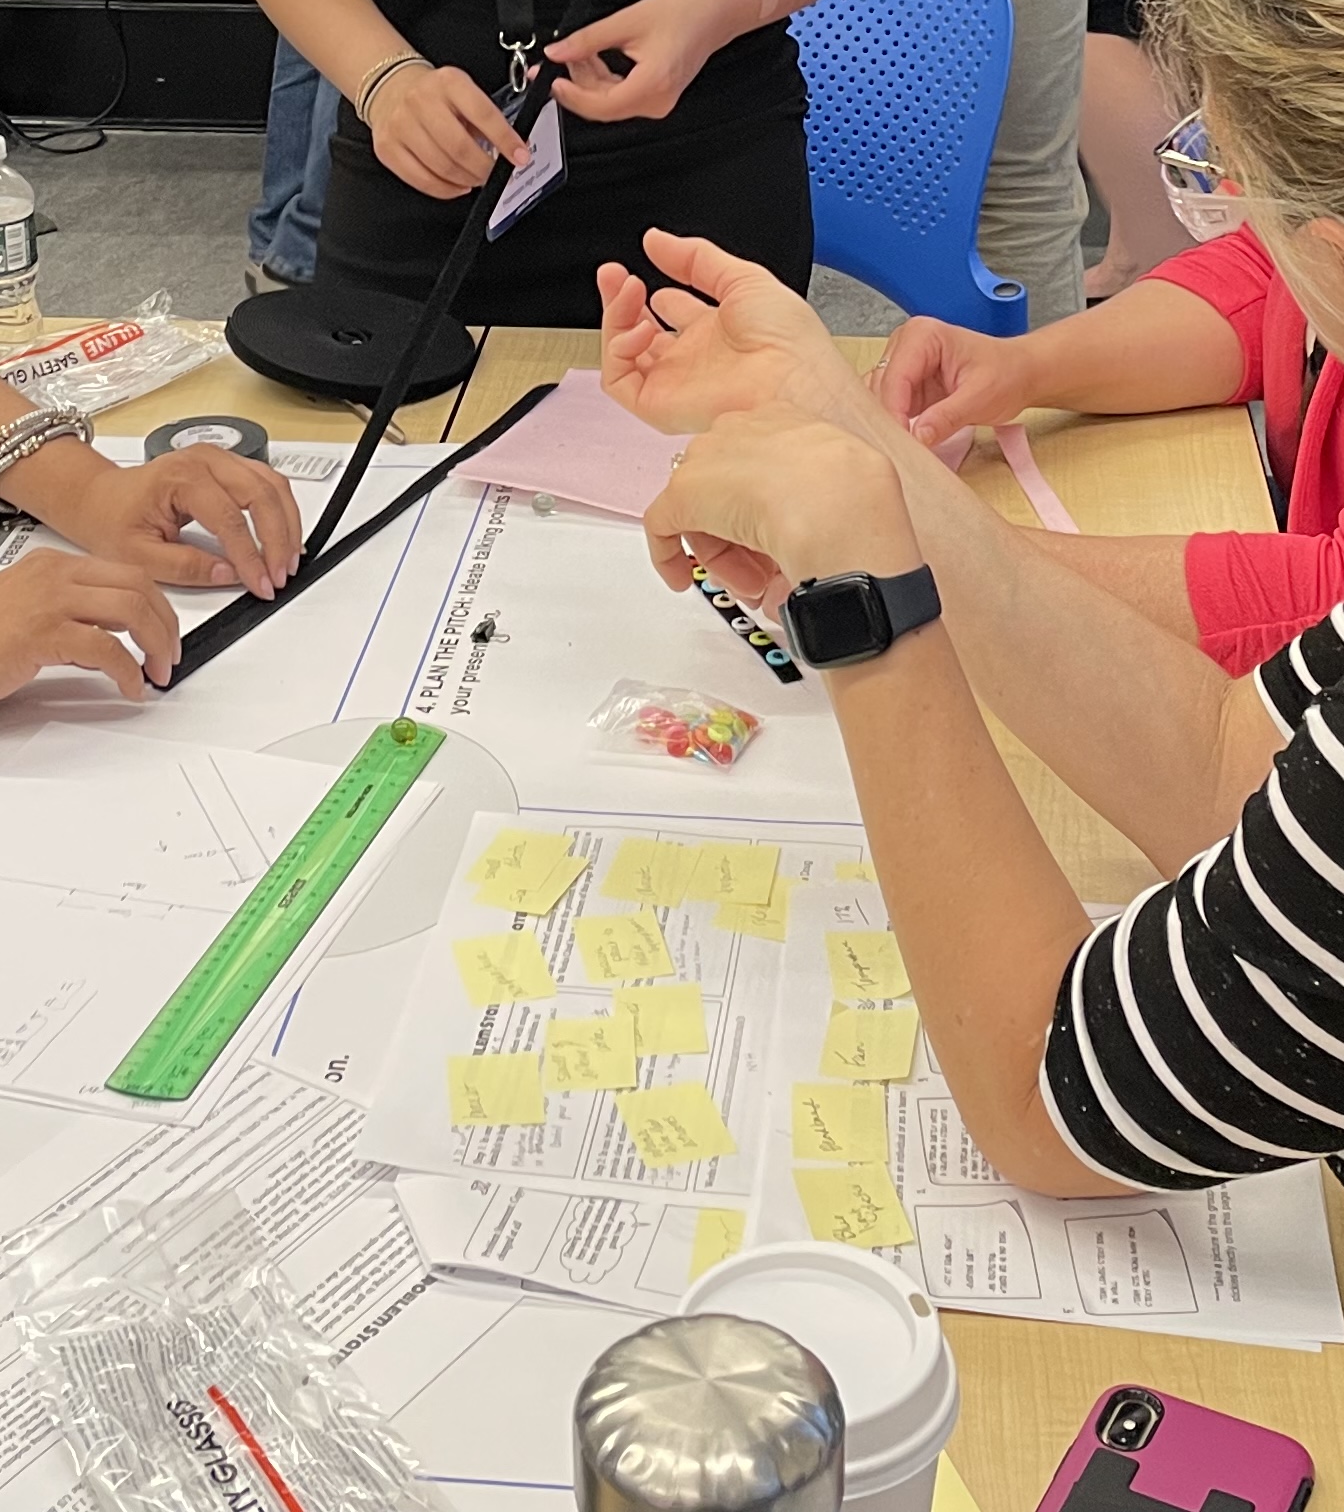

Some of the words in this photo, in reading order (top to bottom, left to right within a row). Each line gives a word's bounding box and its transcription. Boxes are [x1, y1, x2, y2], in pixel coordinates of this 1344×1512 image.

[83, 323, 142, 358] ULINE
[31, 351, 80, 381] SAFETY
[487, 494, 512, 535] points
[472, 527, 504, 562] talking
[458, 561, 486, 596] Ideate
[443, 595, 475, 639] PITCH:
[432, 637, 460, 667] THE
[419, 664, 450, 703] PLAN
[415, 702, 438, 715] 4.
[449, 685, 472, 716] your
[1208, 1213, 1218, 1226] the
[1211, 1237, 1224, 1262] picture
